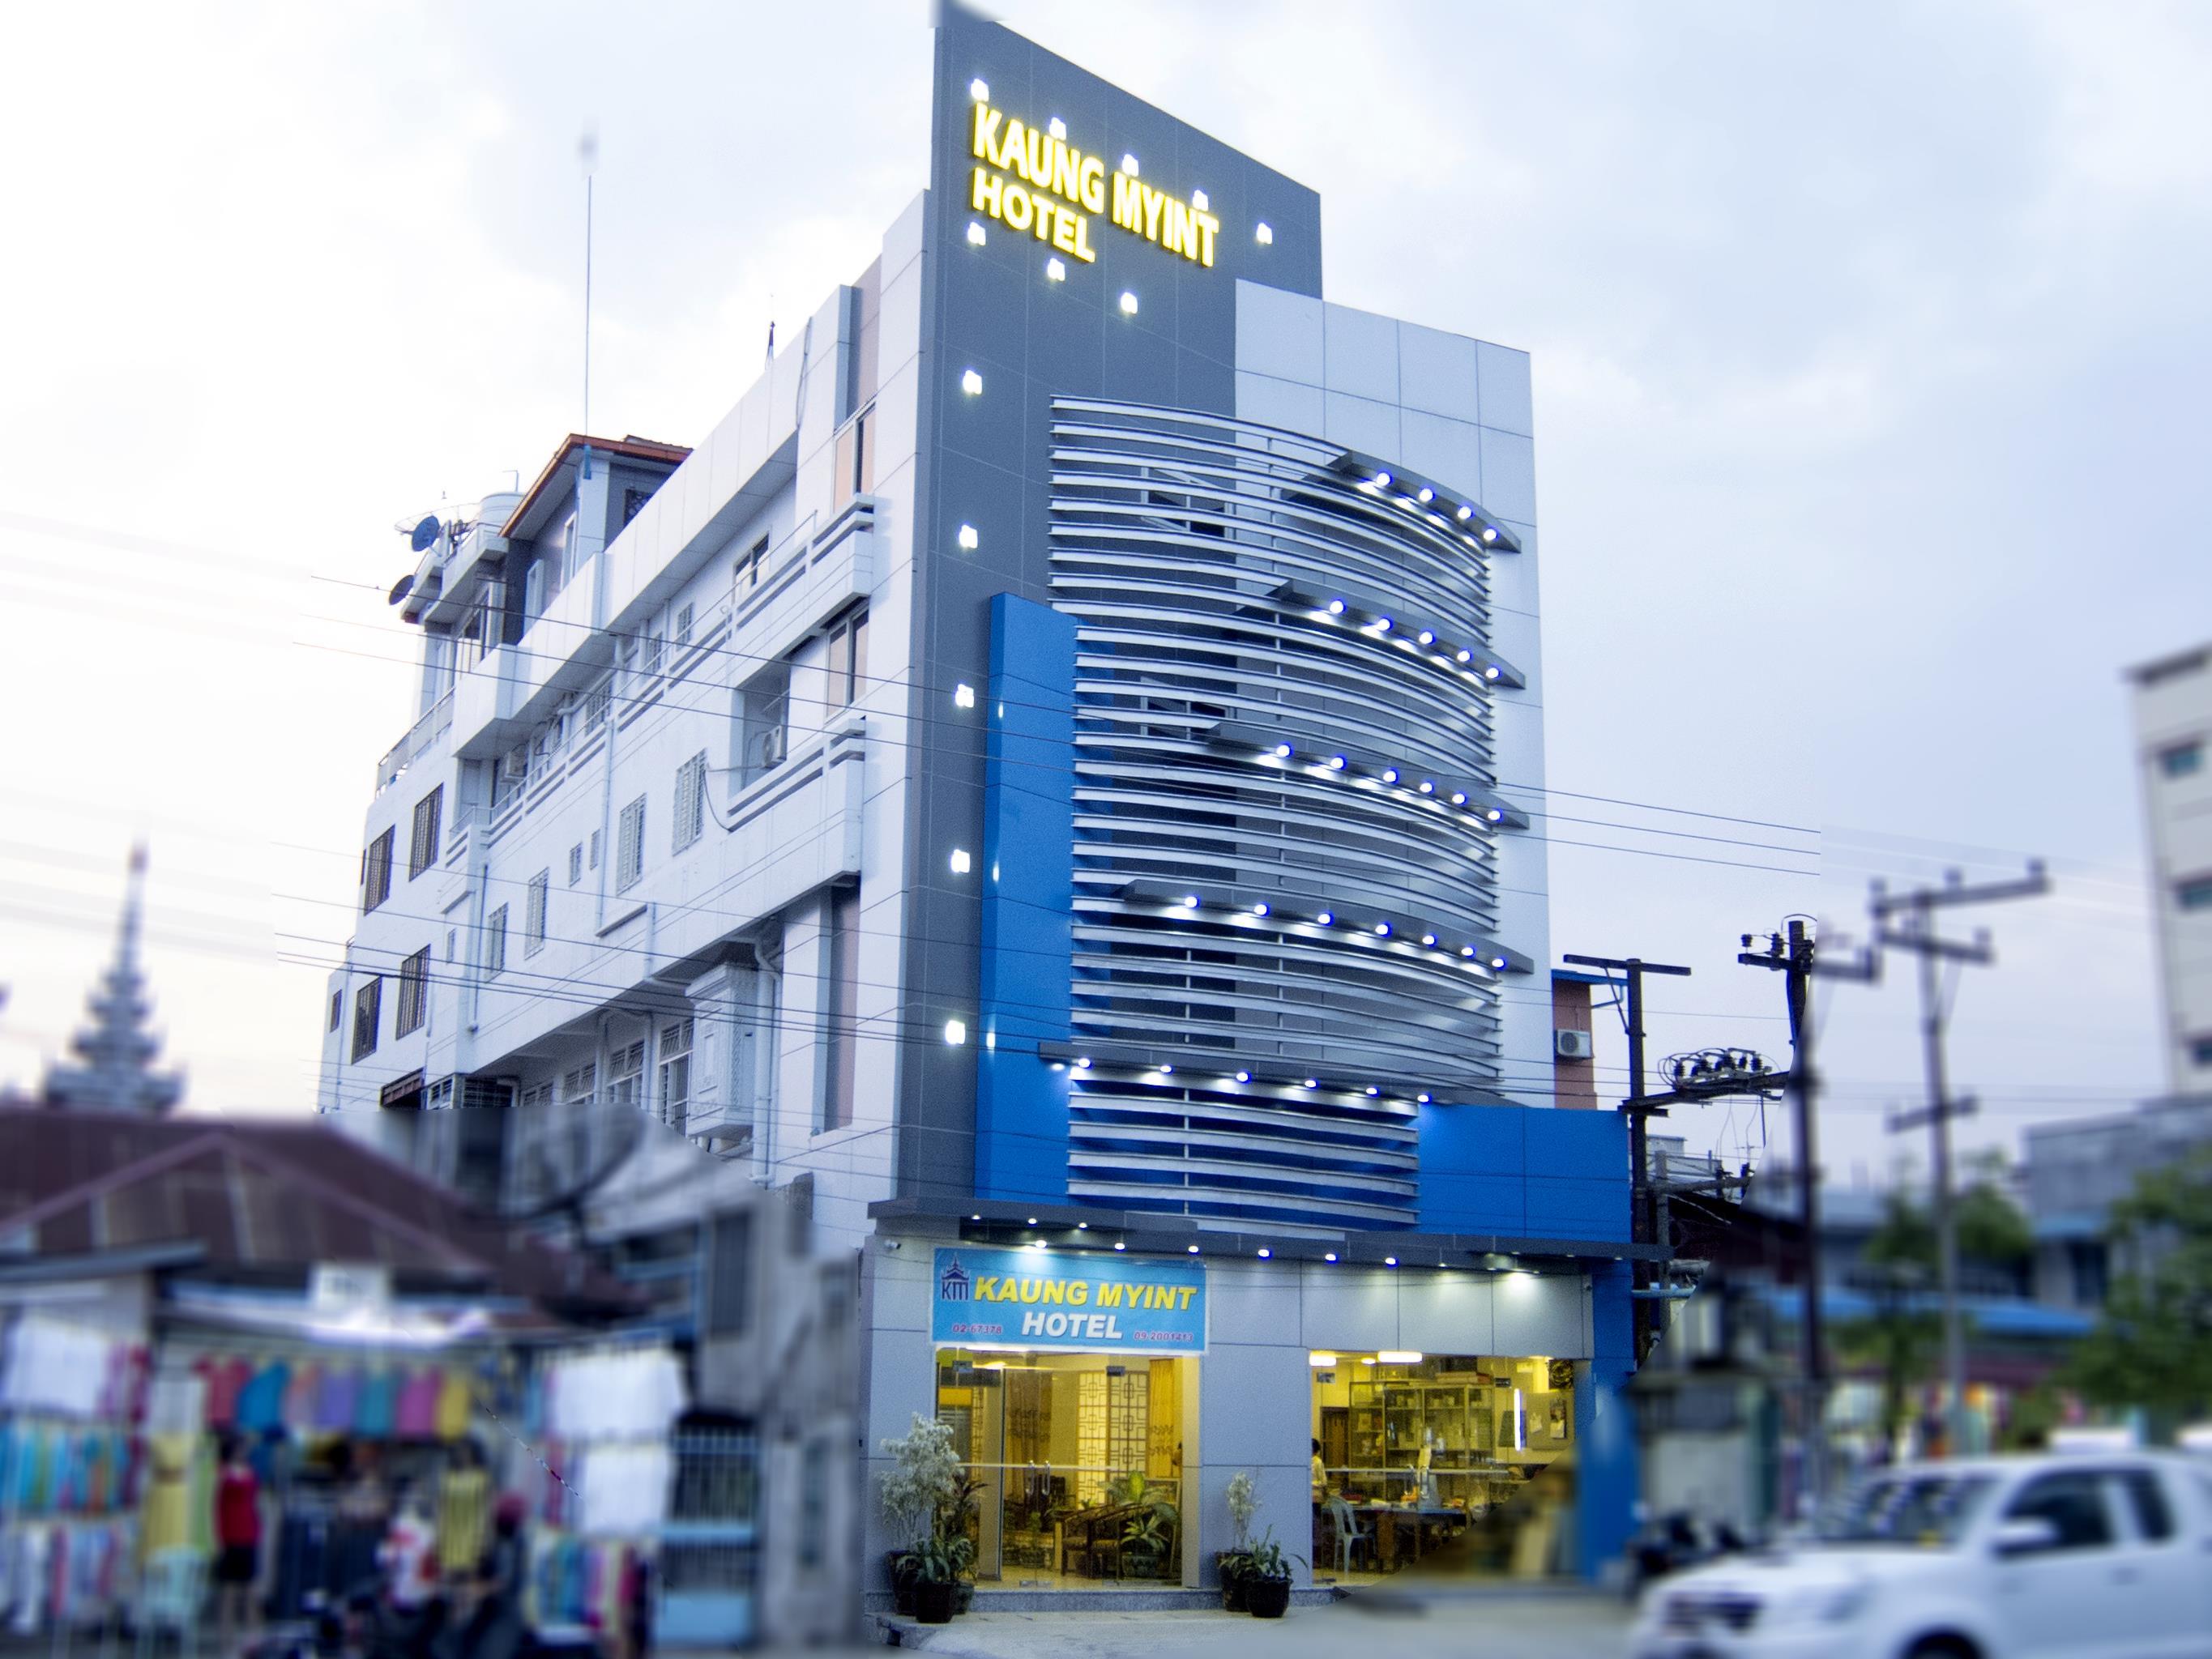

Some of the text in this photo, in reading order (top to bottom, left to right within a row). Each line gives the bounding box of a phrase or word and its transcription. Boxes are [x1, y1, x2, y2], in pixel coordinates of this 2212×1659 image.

[972, 167, 1095, 262] HOTEL
[974, 101, 1219, 267] KAUNG MYINT
[974, 1276, 1198, 1310] KAUNG MYINT
[1021, 1311, 1123, 1340] HOTEL
